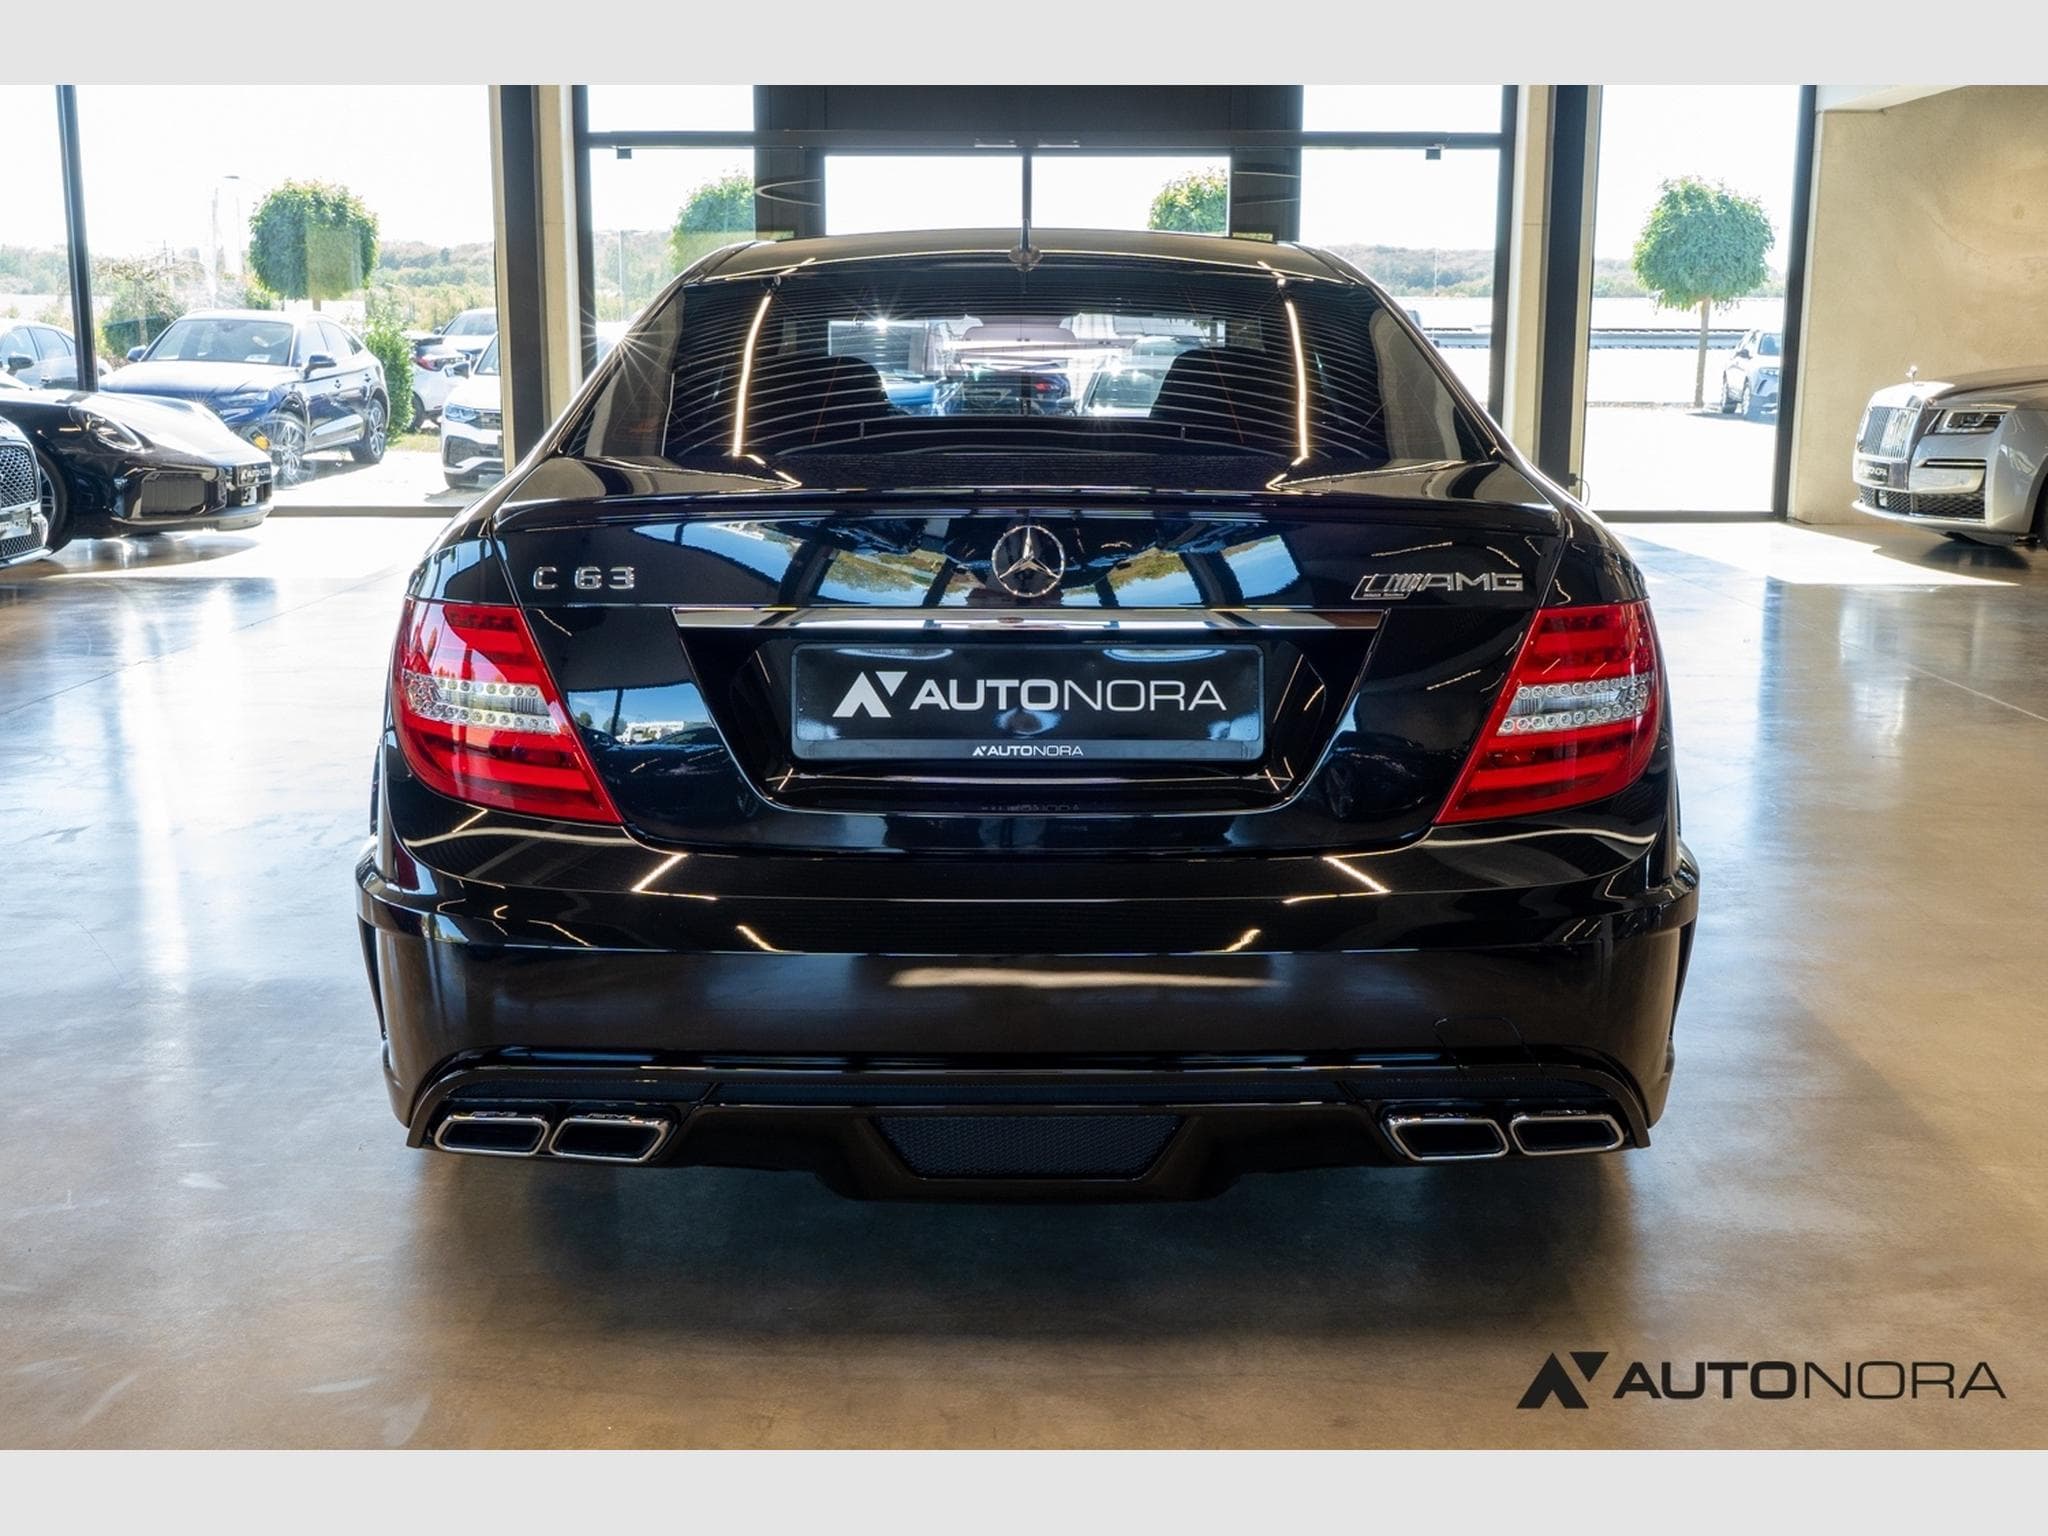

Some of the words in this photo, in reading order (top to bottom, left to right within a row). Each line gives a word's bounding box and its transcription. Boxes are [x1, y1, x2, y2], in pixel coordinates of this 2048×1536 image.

[533, 566, 557, 589] C
[574, 566, 635, 589] 63
[1417, 572, 1524, 592] AMG
[909, 679, 1227, 711] AUTONORA
[986, 745, 1084, 756] AUTONORA
